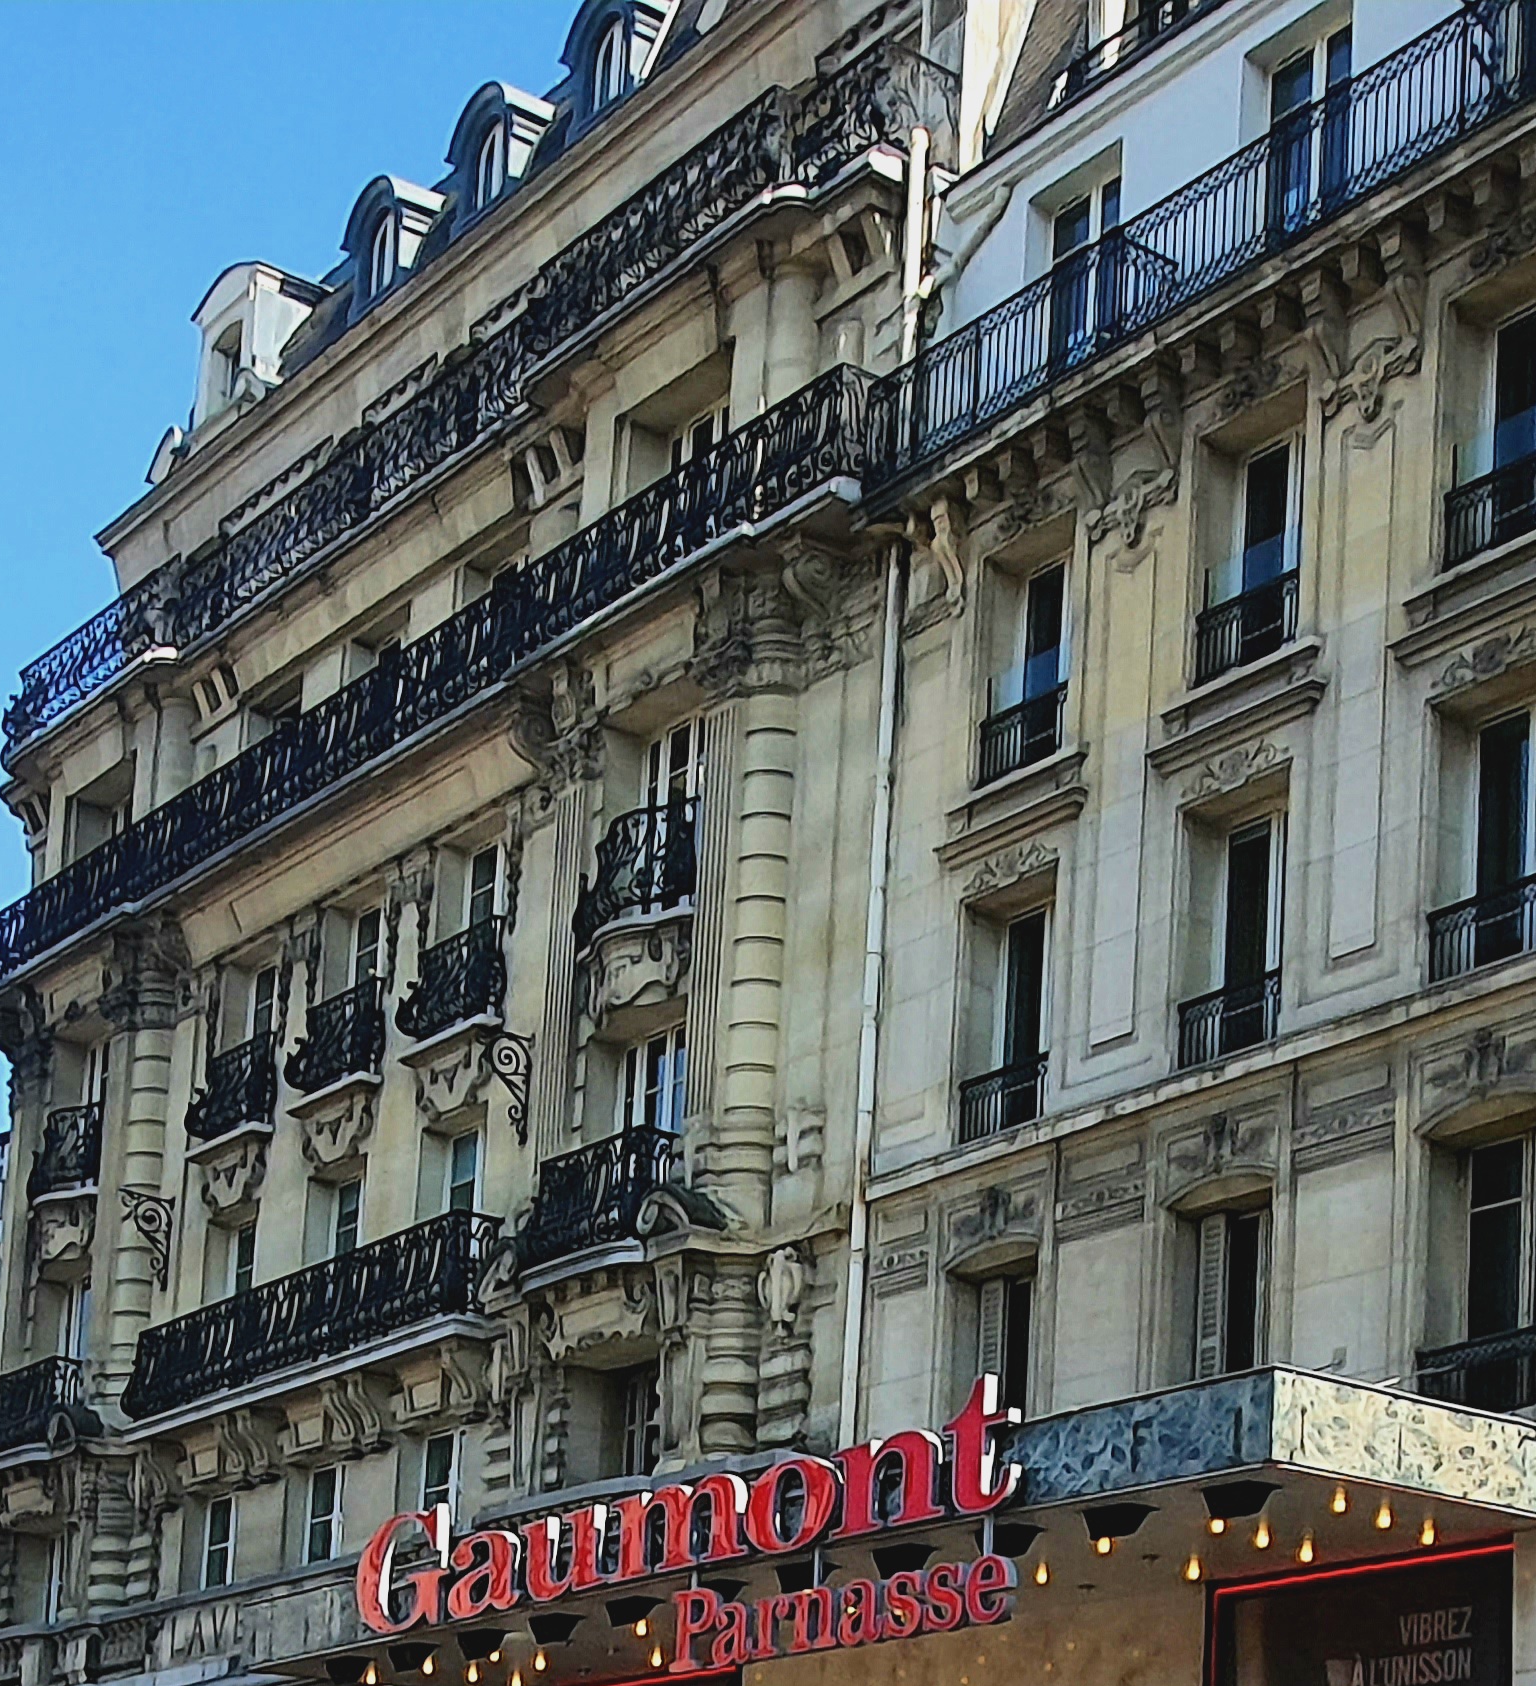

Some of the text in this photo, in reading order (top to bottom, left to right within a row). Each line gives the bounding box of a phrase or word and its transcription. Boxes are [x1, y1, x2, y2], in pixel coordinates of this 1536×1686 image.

[357, 1372, 1022, 1634] Gaumont
[669, 1554, 1017, 1674] Parnasse
[1399, 1605, 1473, 1646] VIBREZ
